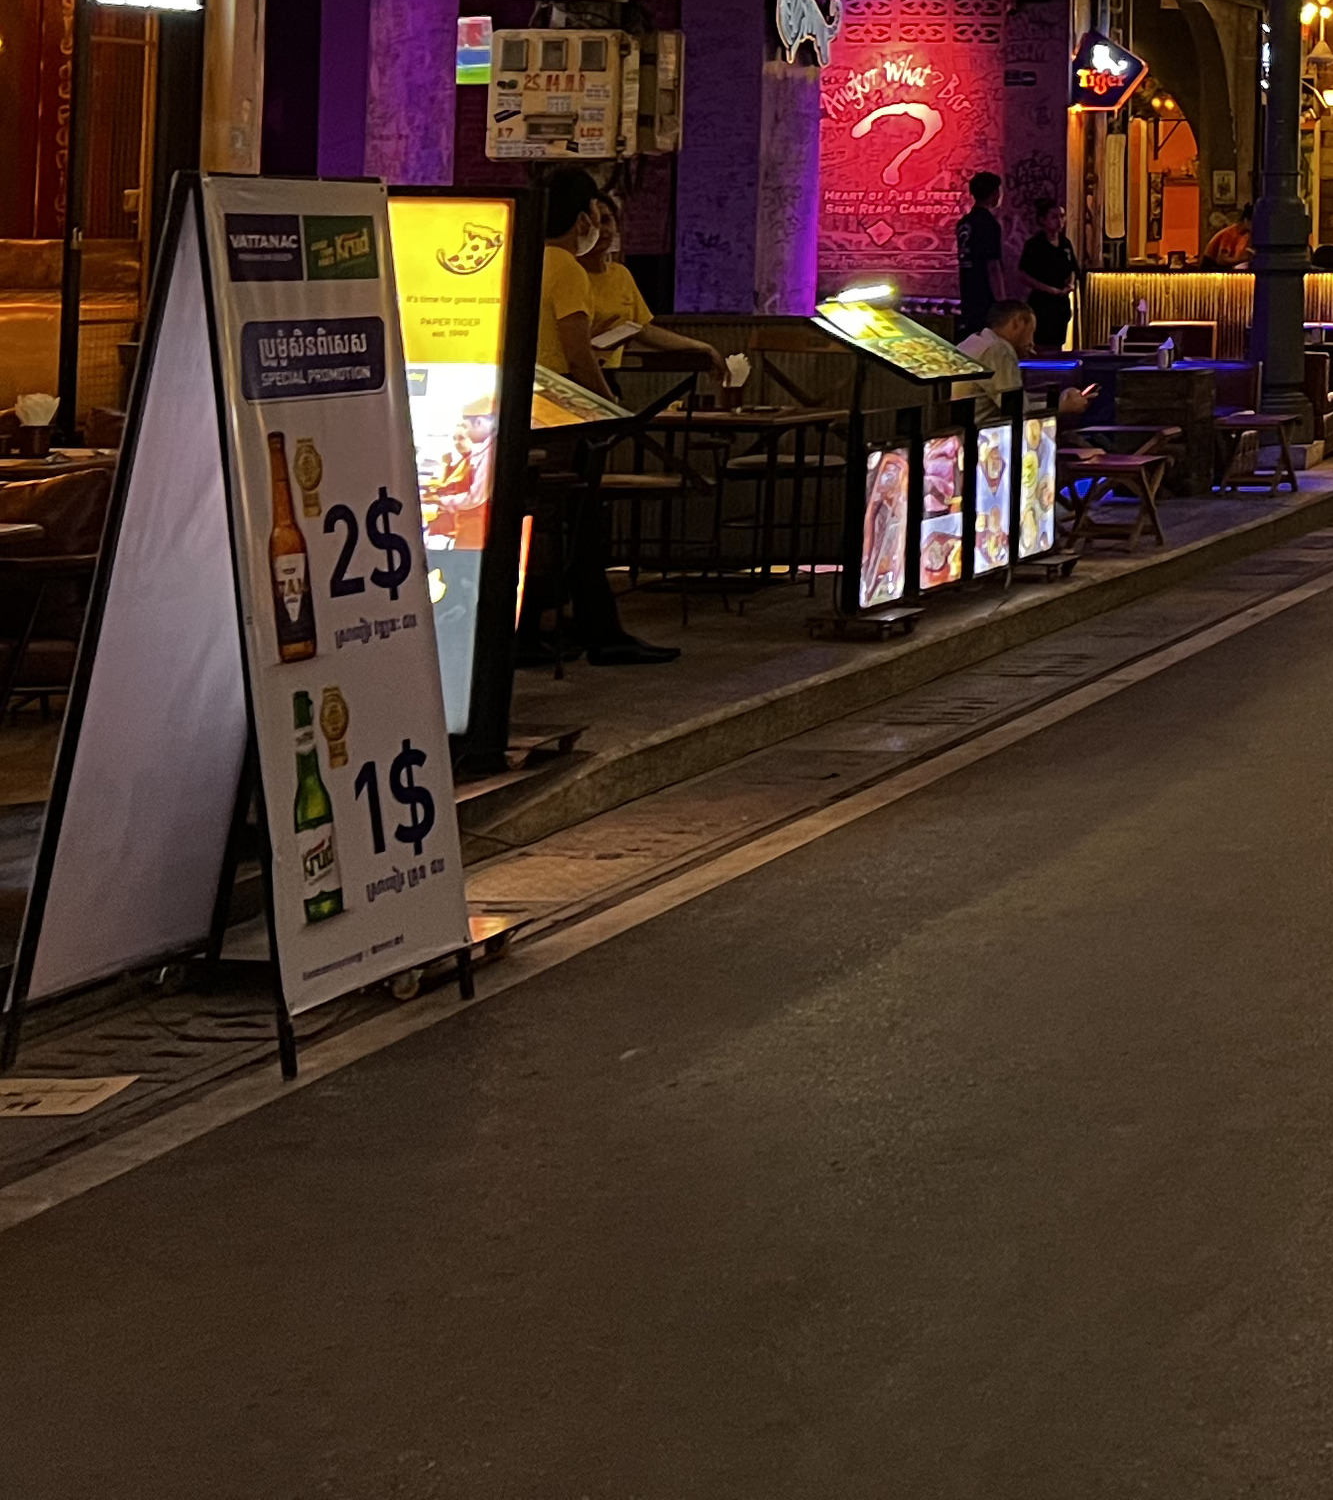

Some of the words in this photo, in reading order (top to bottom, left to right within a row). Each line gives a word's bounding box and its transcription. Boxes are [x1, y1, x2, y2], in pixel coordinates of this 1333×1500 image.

[1076, 68, 1127, 95] Tiger
[824, 190, 865, 201] HEART
[888, 190, 913, 201] PUB
[917, 190, 963, 201] STREET
[825, 204, 855, 215] SIEM
[899, 203, 961, 215] CAMBODIA
[229, 234, 299, 250] VATTANAC
[420, 318, 451, 328] PAPER
[453, 318, 481, 328] TIGER
[307, 365, 371, 384] PROMOTION
[322, 486, 413, 601] 2$
[354, 738, 436, 857] 1$
